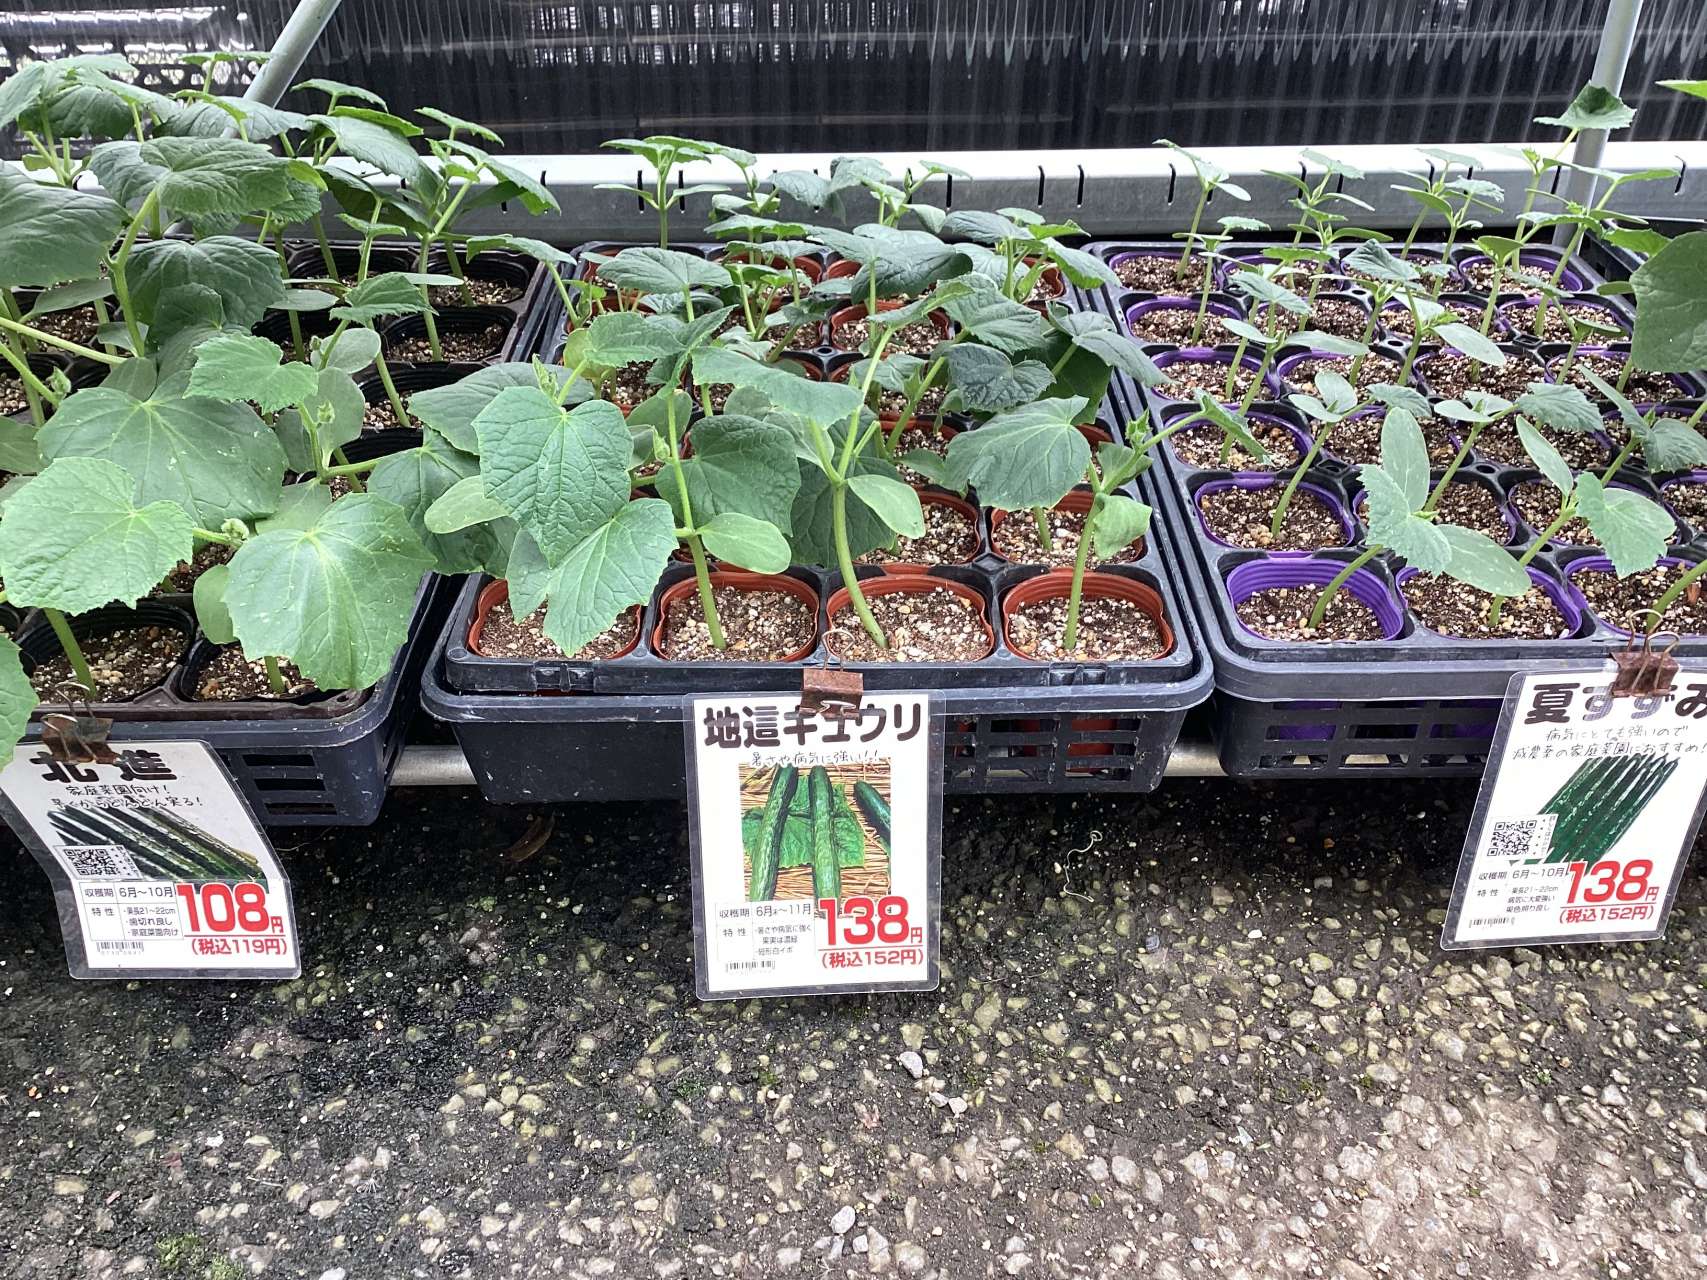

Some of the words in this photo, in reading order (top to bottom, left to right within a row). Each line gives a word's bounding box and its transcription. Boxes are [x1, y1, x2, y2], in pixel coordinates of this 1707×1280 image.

[1559, 906, 1654, 924] (税込152円)
[191, 938, 288, 956] (税込119円)
[821, 948, 924, 969] (税込152円)
